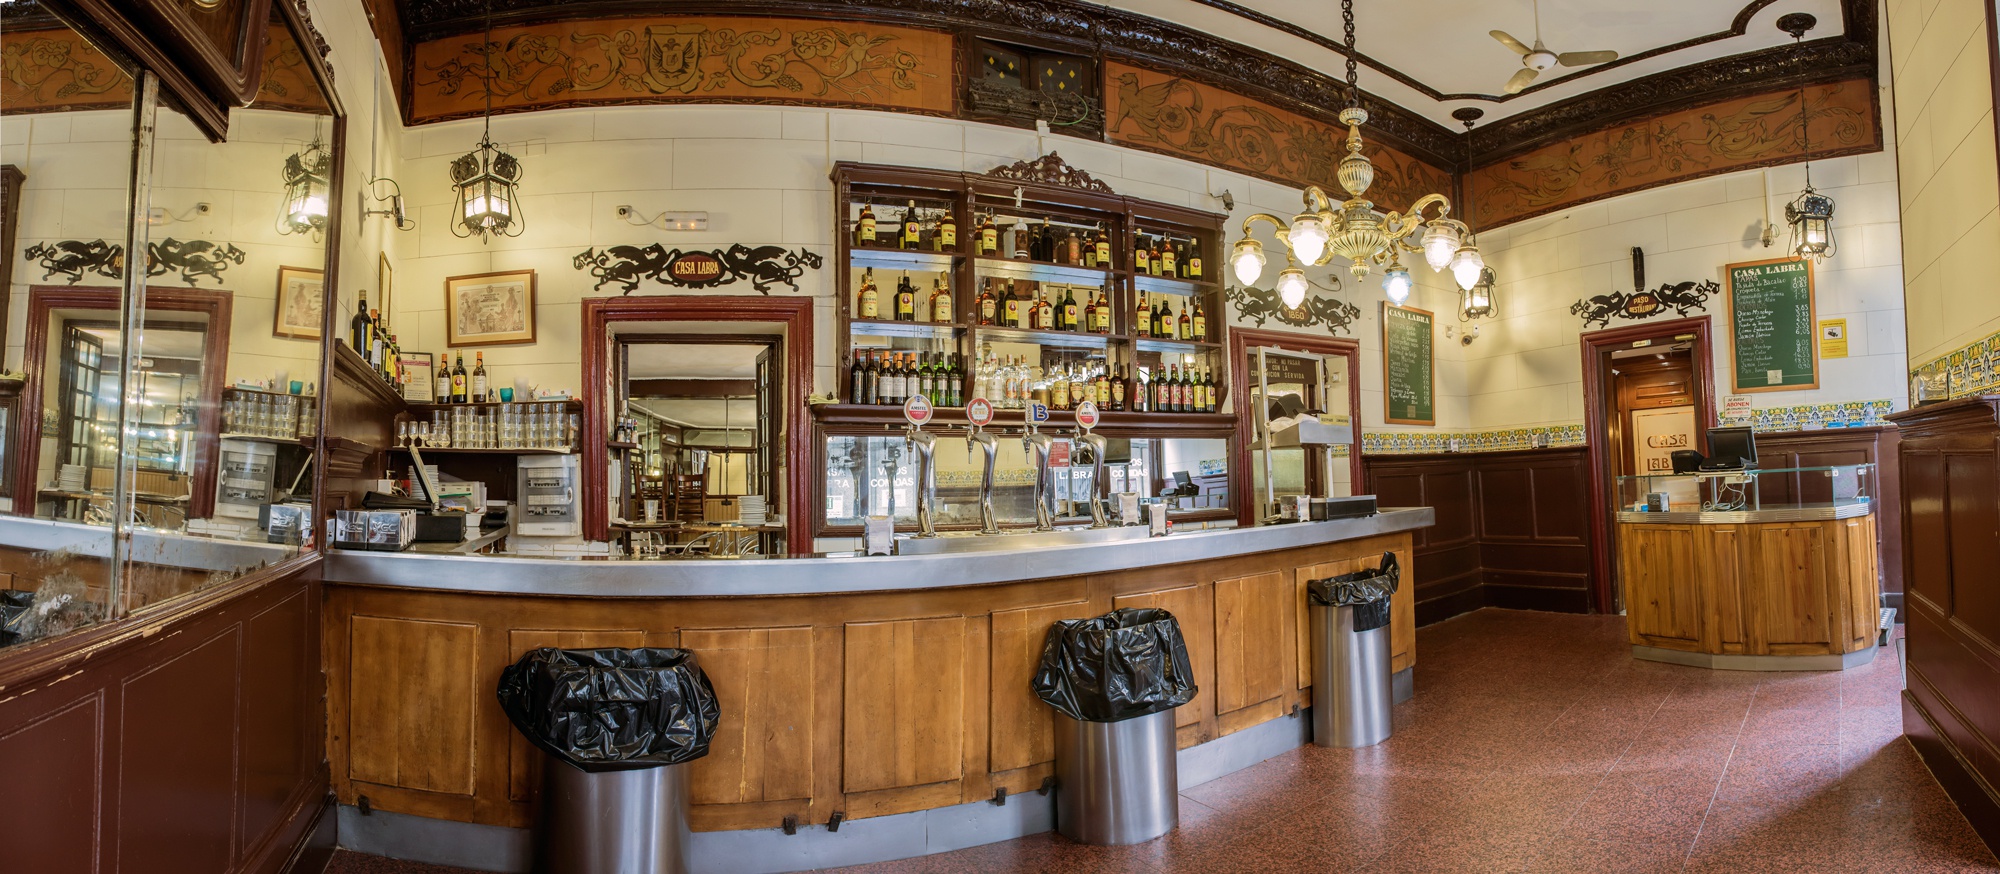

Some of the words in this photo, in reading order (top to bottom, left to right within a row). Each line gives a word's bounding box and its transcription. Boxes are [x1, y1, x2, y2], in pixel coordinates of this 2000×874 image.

[675, 261, 696, 274] CASA
[697, 261, 720, 274] LABRA
[1734, 268, 1762, 278] CASA
[1766, 264, 1805, 274] LABRA
[1764, 278, 1786, 286] Bacalao
[1634, 296, 1649, 304] PASO
[1288, 311, 1304, 320] 1860
[1388, 309, 1406, 318] CASA
[1408, 314, 1429, 324] LABRA
[1647, 434, 1688, 448] CASA
